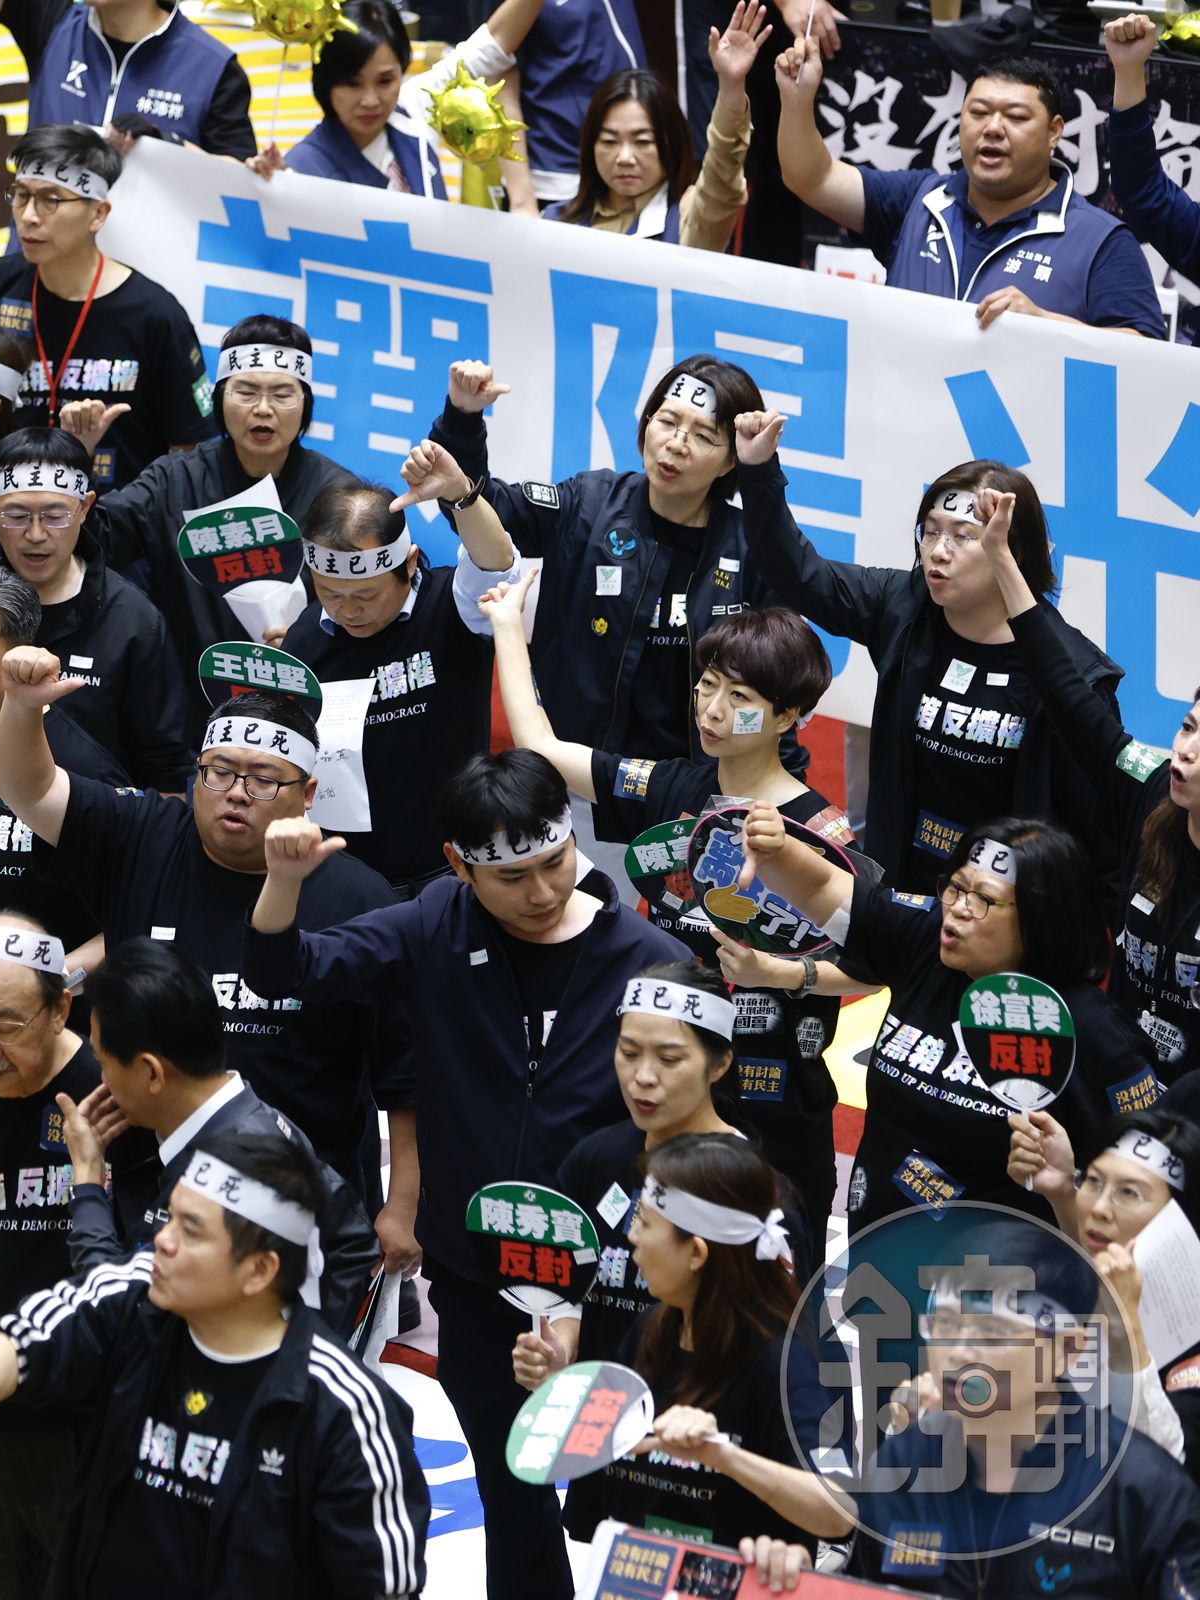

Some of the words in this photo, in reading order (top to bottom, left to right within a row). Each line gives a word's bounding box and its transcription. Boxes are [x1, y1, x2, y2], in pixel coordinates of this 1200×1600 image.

[229, 347, 307, 376] 民主已死
[3, 465, 87, 496] 民主已死
[187, 512, 286, 557] 陳素月
[213, 546, 282, 584] 反對
[308, 548, 393, 576] 民主已死
[212, 651, 310, 695] 王世堅
[370, 650, 437, 703] 擴權
[205, 720, 290, 755] 民主已死
[941, 701, 1028, 750] 反擴權
[939, 743, 1007, 765] DEMOCRACY
[674, 919, 689, 931] UP
[736, 1005, 777, 1018] 主倒退的
[969, 989, 1062, 1034] 徐富癸
[221, 1021, 284, 1036] MOCRACY
[988, 1034, 1053, 1077] 反對
[741, 1077, 780, 1094] 有民主
[900, 1073, 917, 1089] UP
[917, 1079, 939, 1098] FOR
[188, 1160, 241, 1204] 已死
[0, 1219, 19, 1231] FOR
[499, 1240, 572, 1287] 反對
